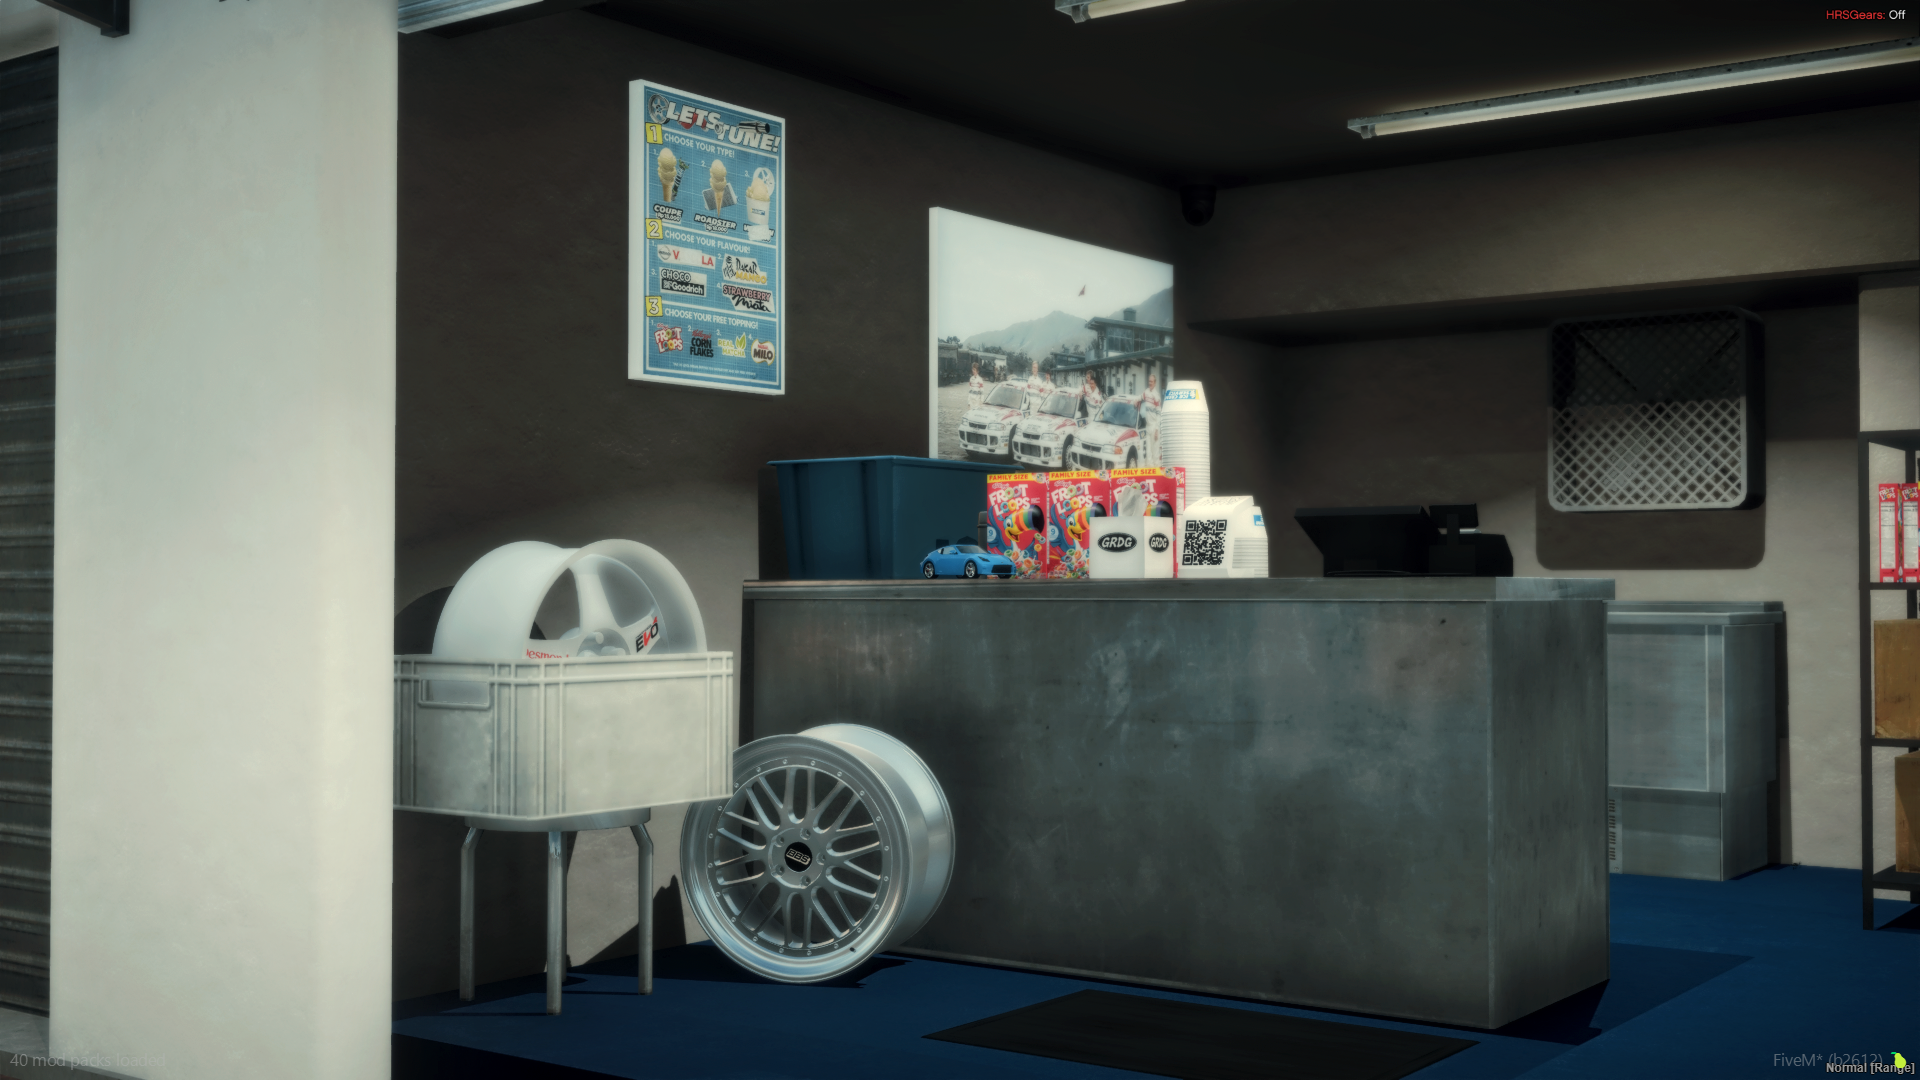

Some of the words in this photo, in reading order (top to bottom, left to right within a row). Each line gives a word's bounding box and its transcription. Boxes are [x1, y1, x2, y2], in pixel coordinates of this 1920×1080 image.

[666, 101, 721, 131] LETS
[649, 125, 658, 143] 1
[715, 124, 781, 152] TUNE!
[664, 133, 694, 148] CHOOSE
[695, 140, 716, 154] YOUR
[717, 146, 735, 158] TYPE!
[653, 203, 683, 218] COUPE
[649, 220, 660, 238] 2
[694, 214, 737, 230] ROADSTER
[664, 230, 695, 243] CHOOSE
[696, 236, 716, 248] YOUR
[717, 240, 751, 254] FLAVOUR!
[672, 249, 680, 260] V
[701, 255, 714, 267] LA
[661, 268, 691, 283] CHOCO
[736, 270, 767, 284] MANGO
[723, 284, 771, 303] STRAWBERRY
[649, 298, 659, 315] 3
[664, 307, 693, 320] CHOOSE
[693, 311, 712, 323] YOUR
[713, 314, 728, 325] FREE
[728, 317, 759, 330] TOPPING!
[654, 326, 682, 344] FROOT
[691, 337, 711, 348] CORN
[718, 339, 735, 348] REAL
[658, 337, 683, 354] LOOPS
[690, 346, 714, 358] FLAKES
[753, 348, 774, 361] MILO
[988, 484, 1028, 507] FROOT
[1051, 481, 1091, 505] FROOT
[994, 496, 1030, 516] LOOPS
[1056, 495, 1093, 515] LOOPS
[1101, 536, 1133, 548] GRDG
[1150, 536, 1168, 548] GRDG
[787, 849, 810, 864] BBS
